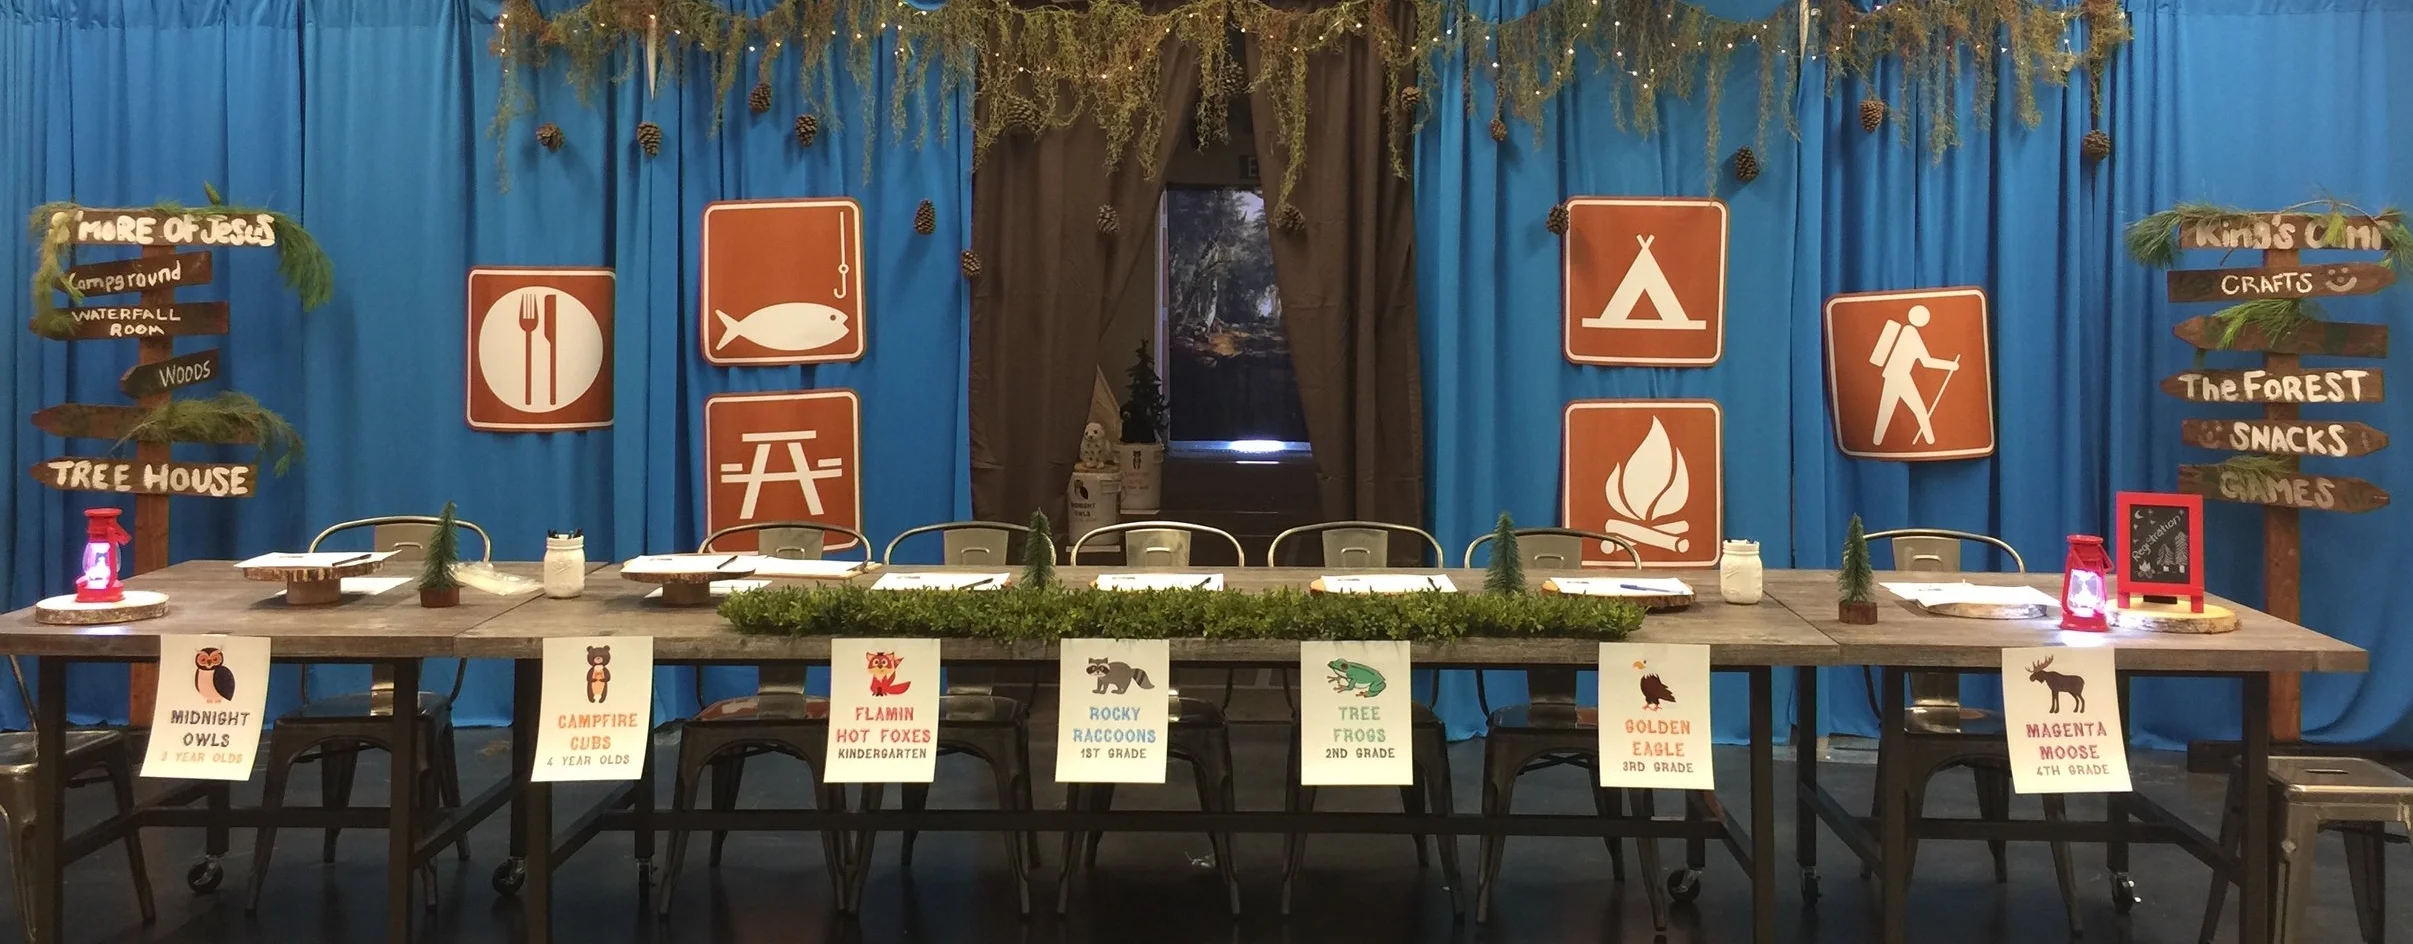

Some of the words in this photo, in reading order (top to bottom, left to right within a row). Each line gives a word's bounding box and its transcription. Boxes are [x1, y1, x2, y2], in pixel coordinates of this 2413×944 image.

[2221, 272, 2314, 295] CRAFTS
[72, 308, 181, 321] WATERFALL
[110, 323, 165, 338] ROOM
[158, 360, 212, 388] WOODS
[2178, 373, 2240, 402] The
[2229, 421, 2349, 458] SNACKS
[48, 460, 132, 493] TREE
[143, 463, 250, 497] HOUSE
[2219, 471, 2336, 510] GAMES
[2131, 514, 2183, 563] Registration
[170, 710, 250, 726] MIDNIGHT
[557, 713, 639, 729] CAMPFIRE
[855, 706, 915, 721] FLAMIN
[1089, 706, 1141, 721] ROCKY
[1338, 706, 1381, 721] TREE
[1624, 719, 1691, 735] GOLDEN
[2025, 721, 2108, 738] MAGENTA
[182, 732, 231, 748] OWLS
[570, 735, 612, 751] CUBS
[836, 728, 870, 743] HOT
[880, 728, 931, 743] FOXES
[1072, 728, 1156, 743] RACCOONS
[1333, 728, 1387, 743] FROGS
[838, 748, 927, 759] KINDERGARTEN
[1080, 748, 1101, 759] 1ST
[1107, 748, 1147, 759] GRADE
[1325, 748, 1348, 759] 2ND
[1355, 748, 1395, 759] GRADE
[1632, 741, 1685, 757] EAGLE
[2039, 744, 2101, 760] MOOSE
[175, 751, 205, 763] YEAR
[212, 752, 243, 764] OLDS
[547, 756, 554, 766] 4
[562, 755, 591, 766] YEAR
[599, 754, 630, 765] OLDS
[1623, 761, 1645, 772] 3RD
[1653, 761, 1694, 773] GRADE
[2036, 765, 2060, 776] 4TH
[2068, 764, 2110, 776] GRADE
